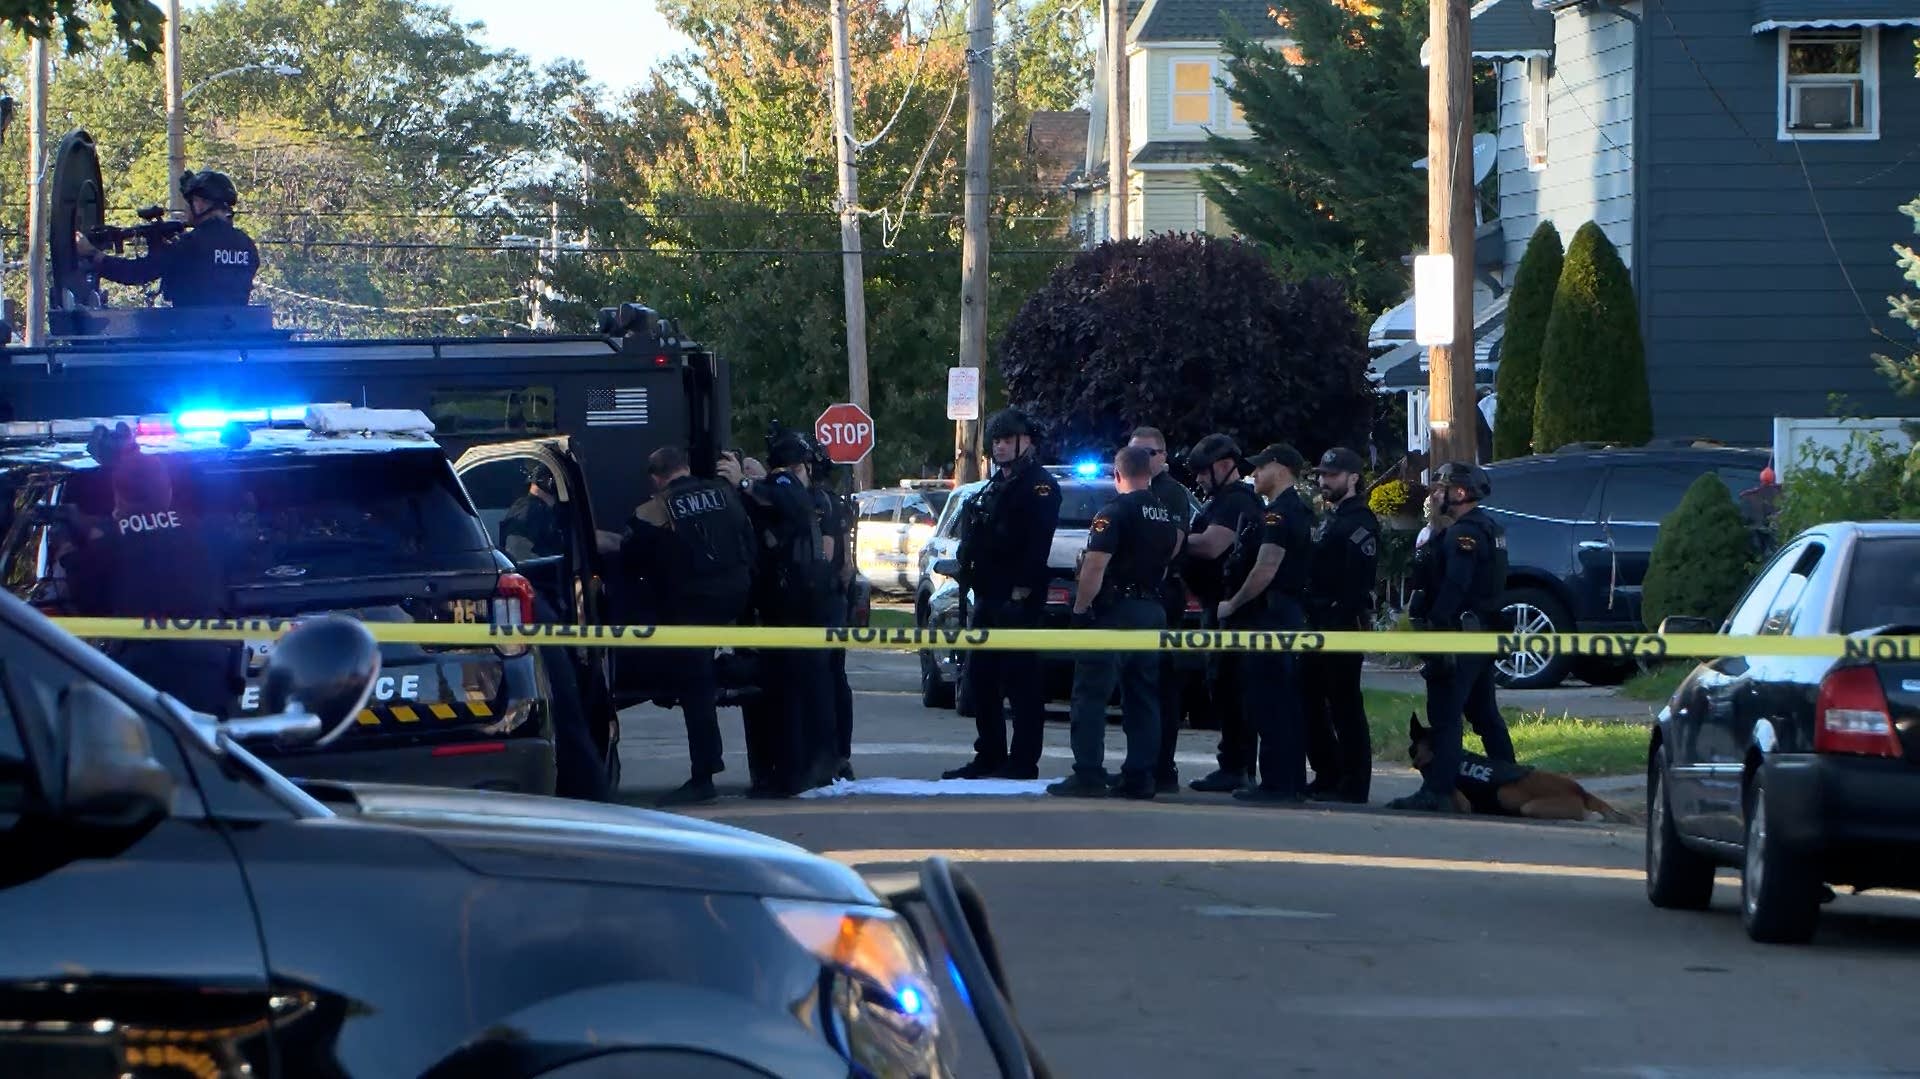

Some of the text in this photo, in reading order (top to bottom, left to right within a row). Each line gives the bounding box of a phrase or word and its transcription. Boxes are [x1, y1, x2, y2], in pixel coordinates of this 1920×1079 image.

[214, 249, 249, 265] POLICE
[820, 423, 869, 445] STOP
[118, 511, 182, 535] POLICE
[1142, 505, 1170, 522] POLICE
[142, 616, 282, 632] AUTION
[489, 623, 656, 638] CAUTION
[826, 627, 989, 644] CAUTION
[1159, 630, 1325, 651] CAUTION
[1497, 633, 1667, 657] CAUTION
[1461, 761, 1493, 782] LICE
